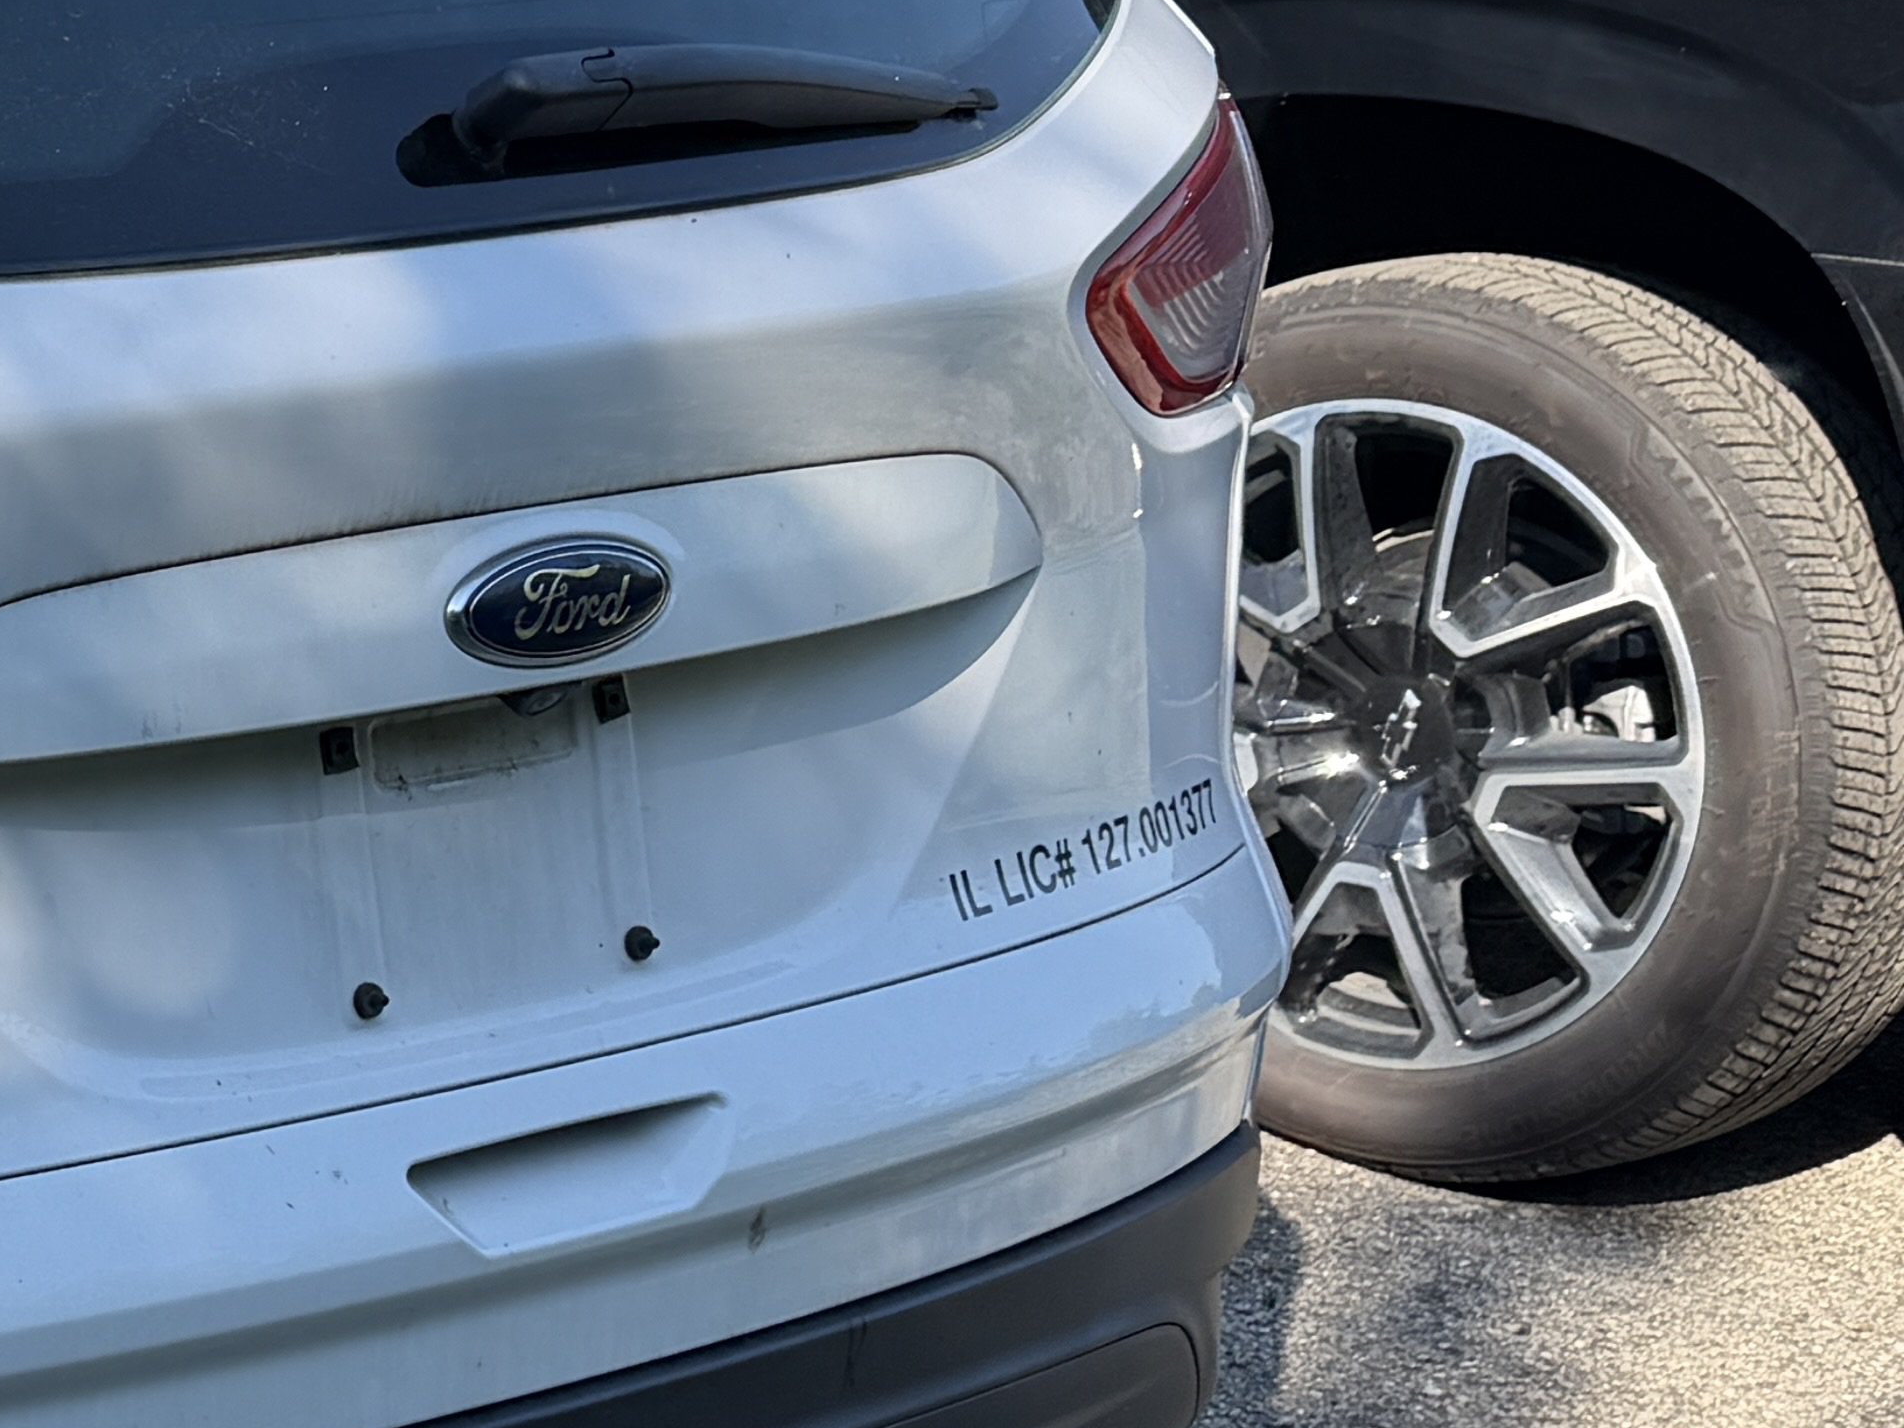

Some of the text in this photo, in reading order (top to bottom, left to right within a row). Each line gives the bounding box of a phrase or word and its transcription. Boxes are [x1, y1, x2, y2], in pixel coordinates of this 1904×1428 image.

[513, 563, 632, 641] Ford
[948, 777, 1217, 922] IL LIC# 127.001377
